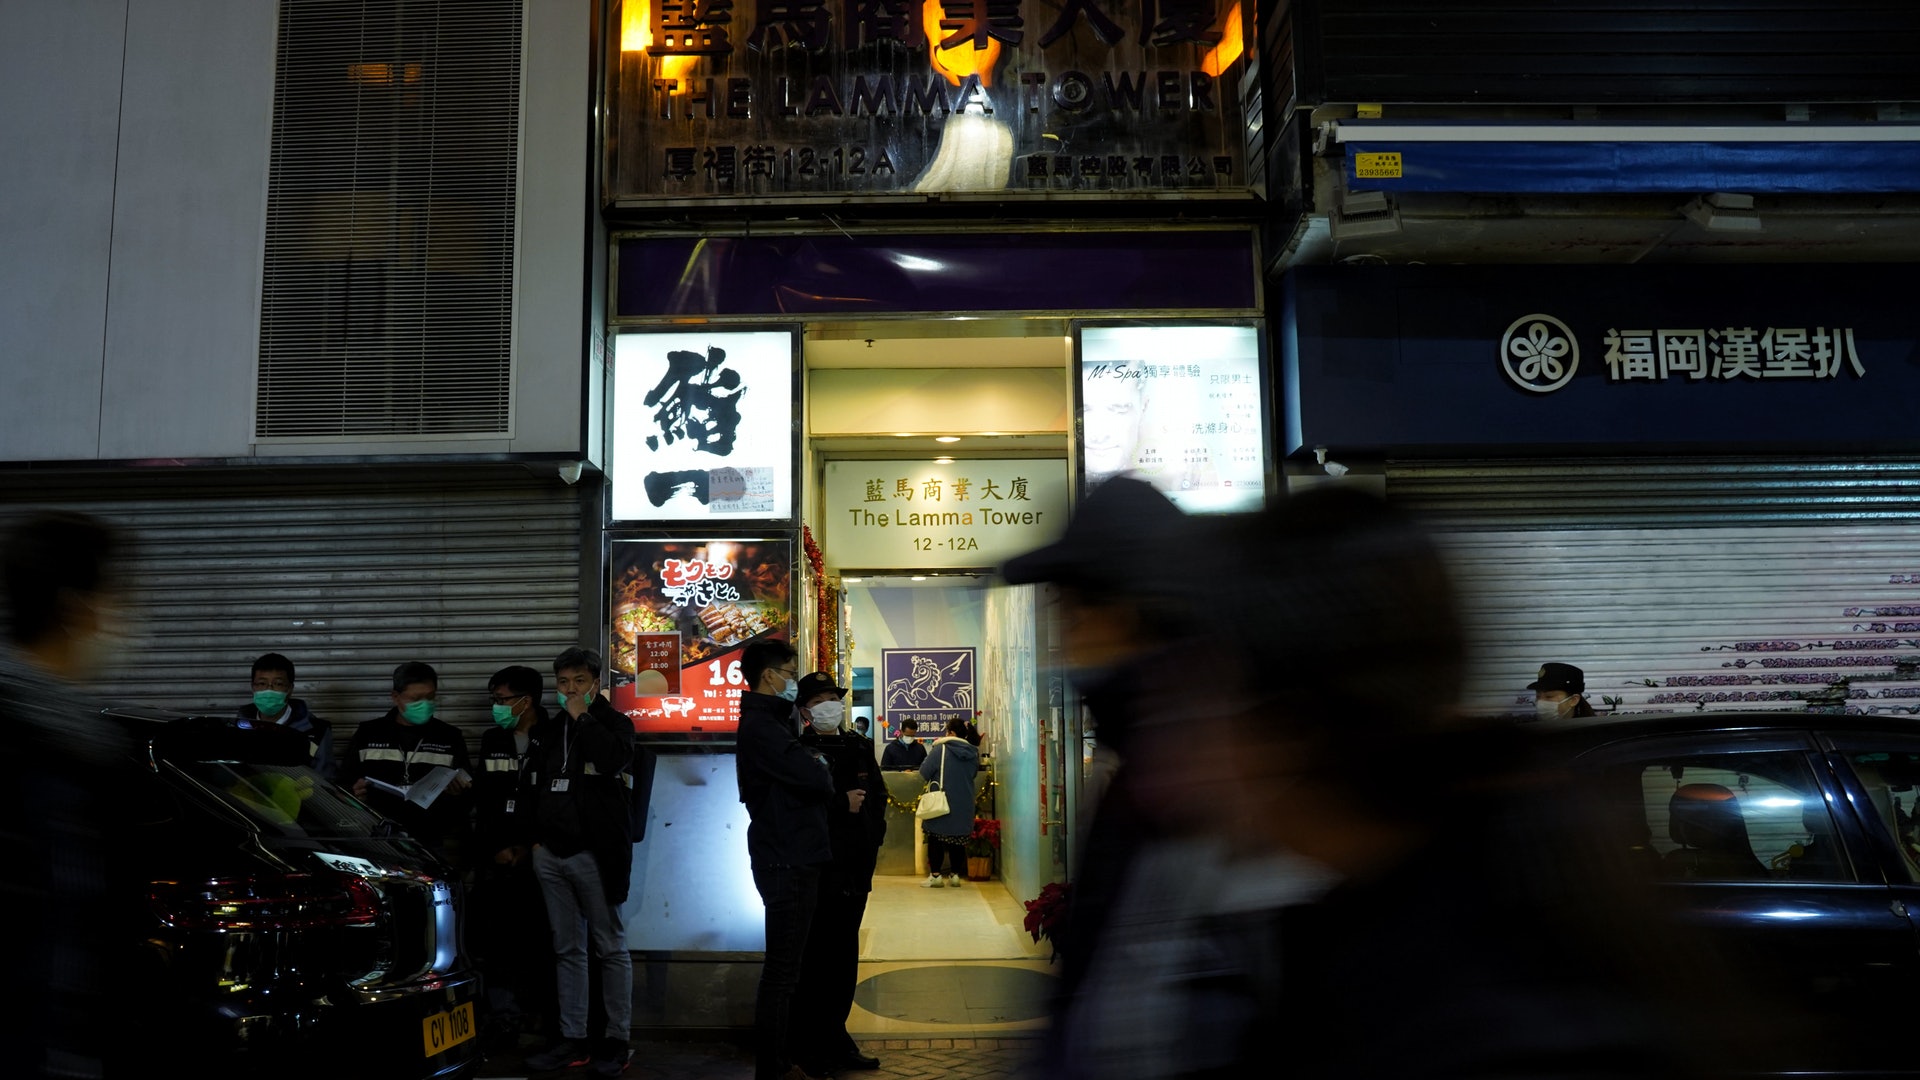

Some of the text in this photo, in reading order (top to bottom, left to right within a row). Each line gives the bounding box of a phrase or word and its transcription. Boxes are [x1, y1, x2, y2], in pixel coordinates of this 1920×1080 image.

[653, 70, 1215, 119] THE LAMMA TOWER
[1027, 155, 1234, 177] 藍馬控股有限公司
[1603, 326, 1866, 380] 福岡漢堡扒
[1142, 363, 1201, 379] 獨享體驗
[1209, 374, 1253, 385] 只限男士
[863, 476, 1032, 502] 藍馬商業大廈
[848, 508, 1044, 527] The Lamma Tower
[913, 537, 932, 551] 12
[948, 537, 979, 551] 12A
[708, 660, 749, 686] 16
[899, 712, 960, 721] The Lamma Tower
[431, 1007, 469, 1049] CV 1108
